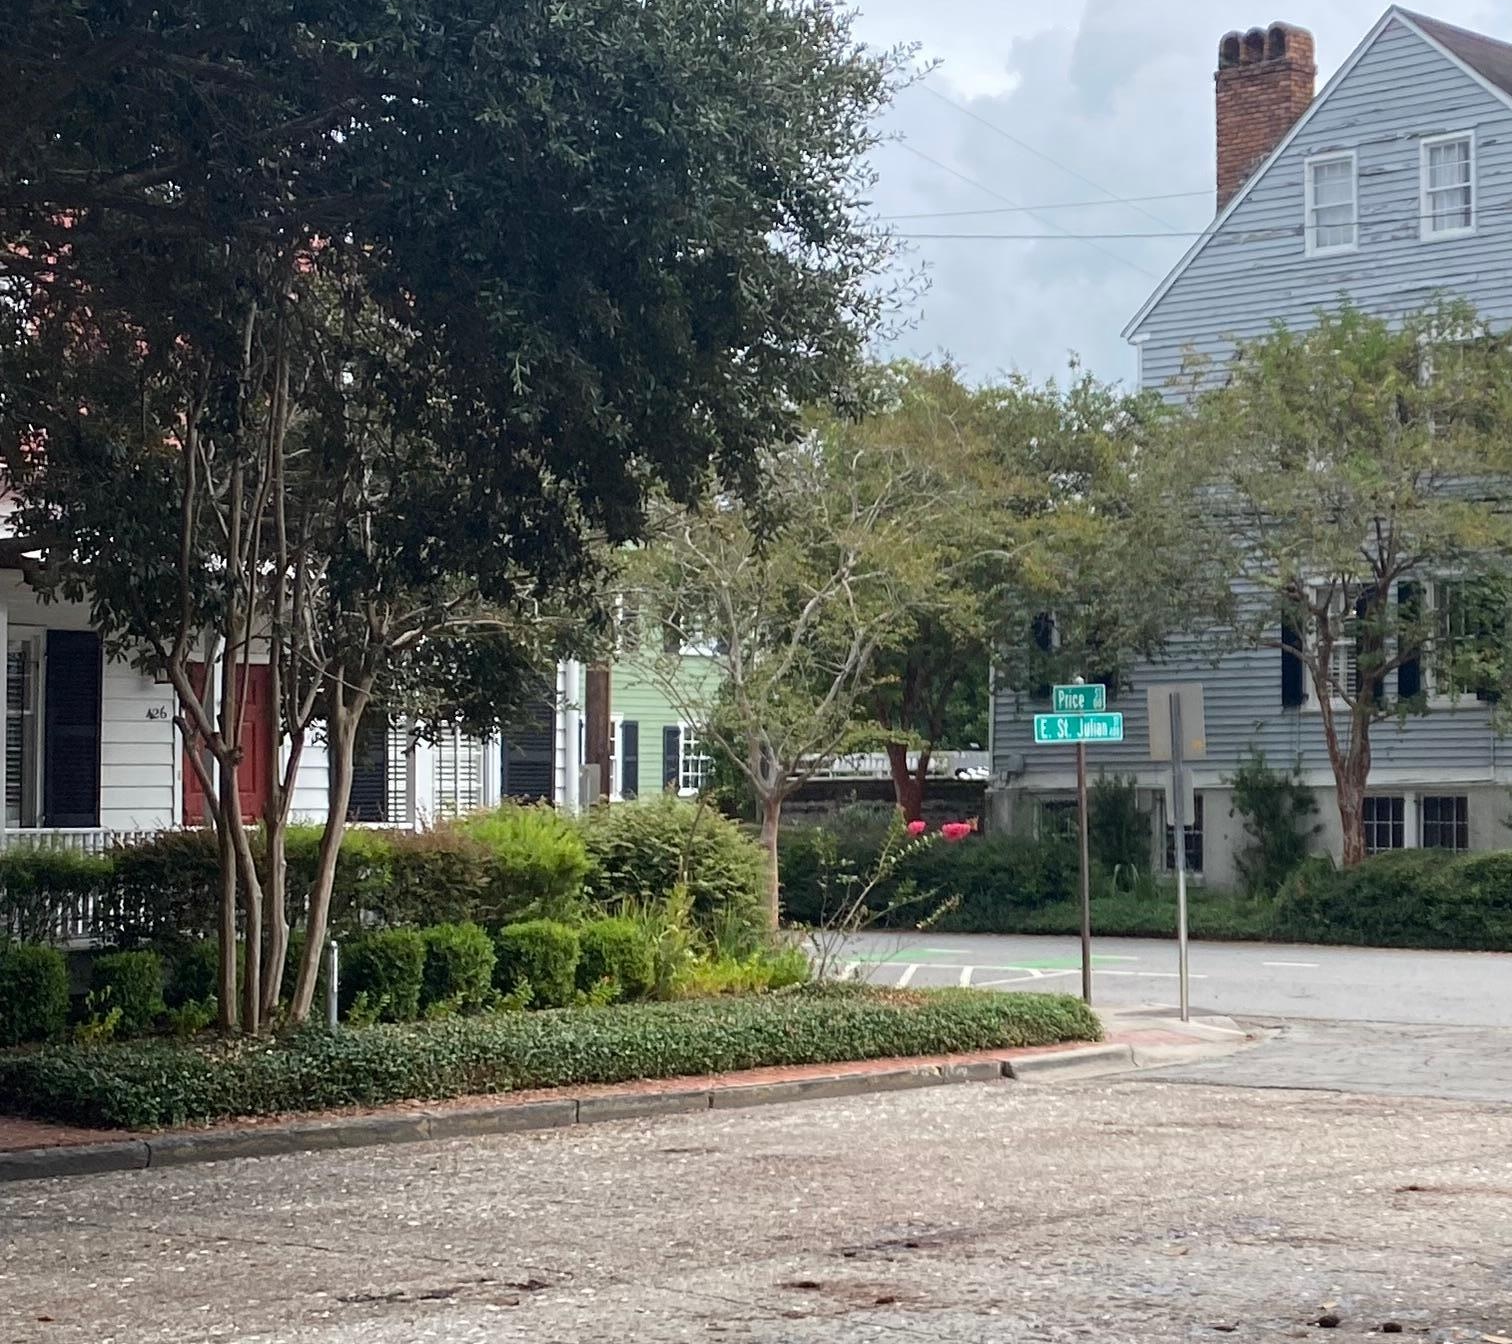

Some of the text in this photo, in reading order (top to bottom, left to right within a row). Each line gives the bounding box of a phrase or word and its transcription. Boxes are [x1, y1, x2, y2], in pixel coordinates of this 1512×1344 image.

[1058, 690, 1085, 709] Price
[146, 705, 167, 719] 426
[1040, 718, 1052, 739] E.
[1077, 717, 1108, 737] Julian
